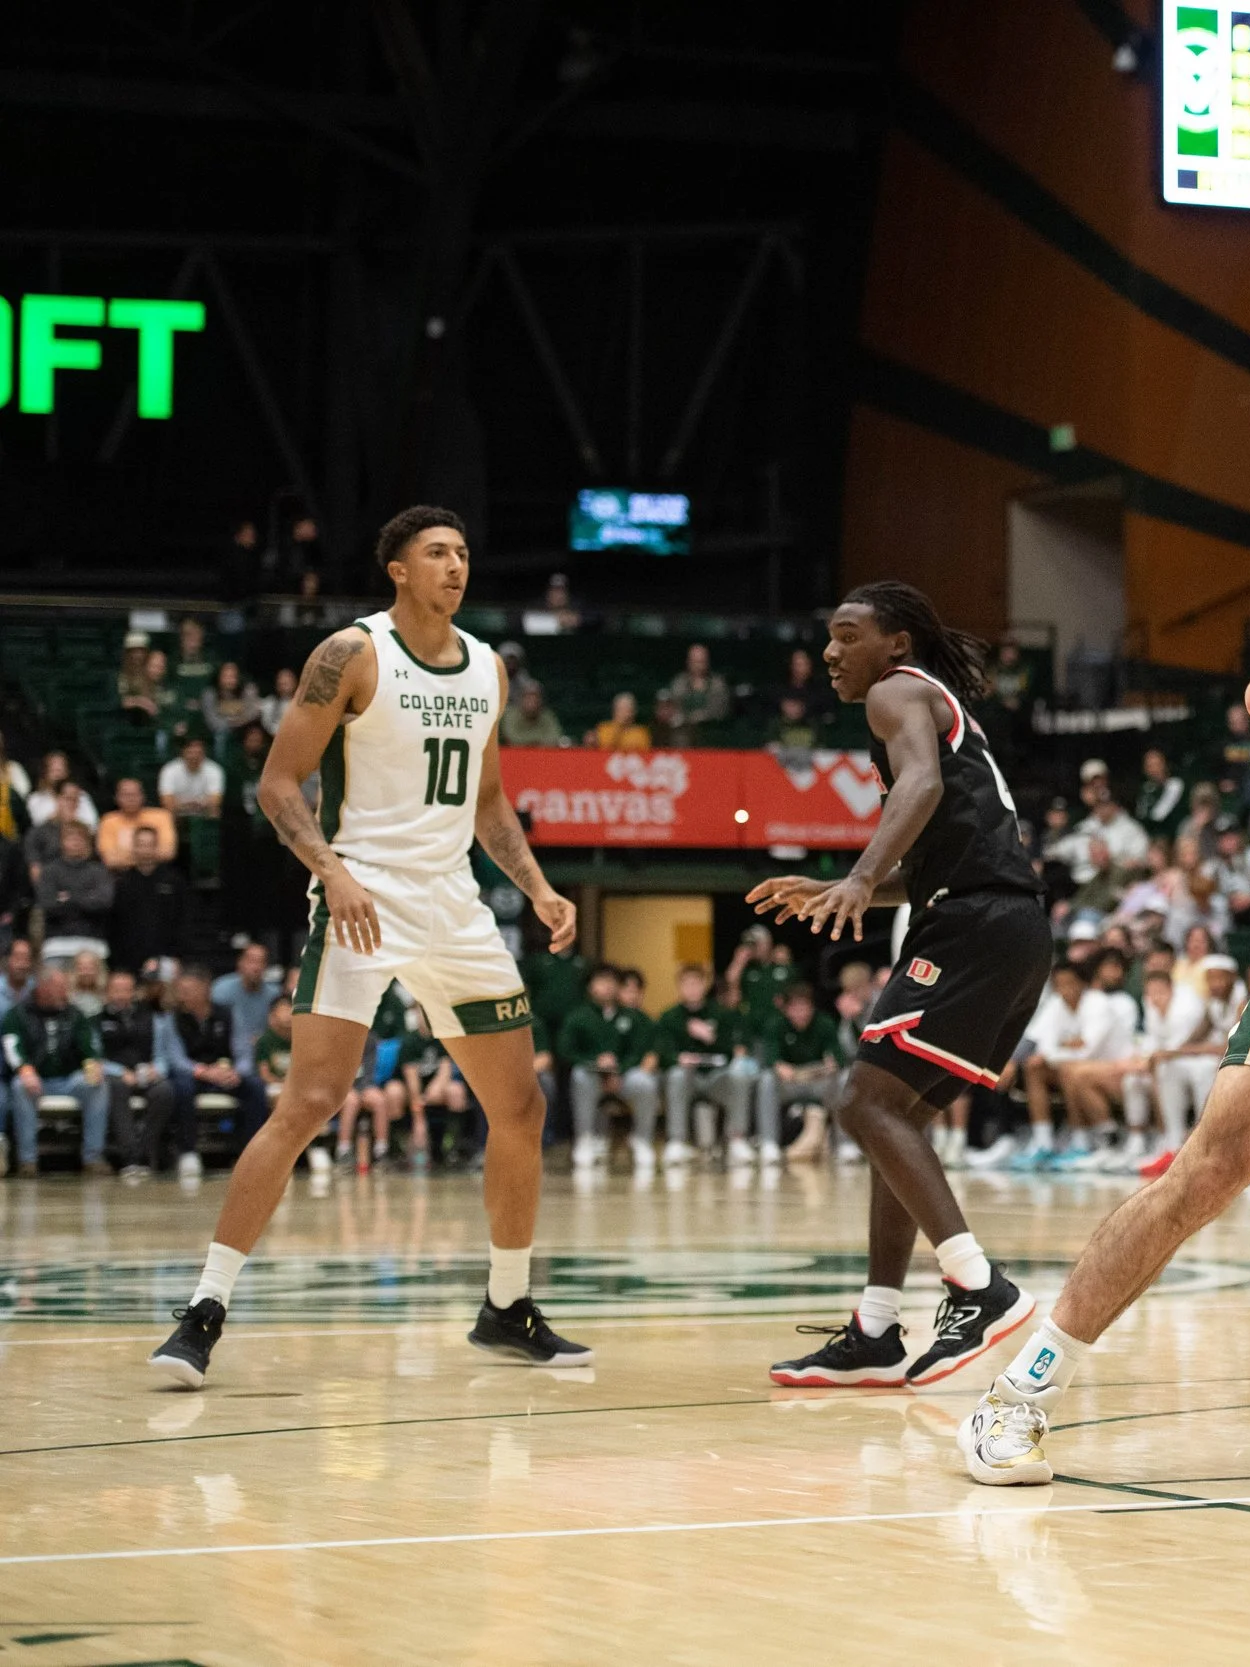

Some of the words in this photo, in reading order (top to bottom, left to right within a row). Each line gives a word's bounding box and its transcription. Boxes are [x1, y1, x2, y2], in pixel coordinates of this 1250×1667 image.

[0, 293, 206, 420] FT
[400, 694, 489, 714] COLORADO
[422, 712, 473, 729] STATE
[423, 737, 470, 806] 10
